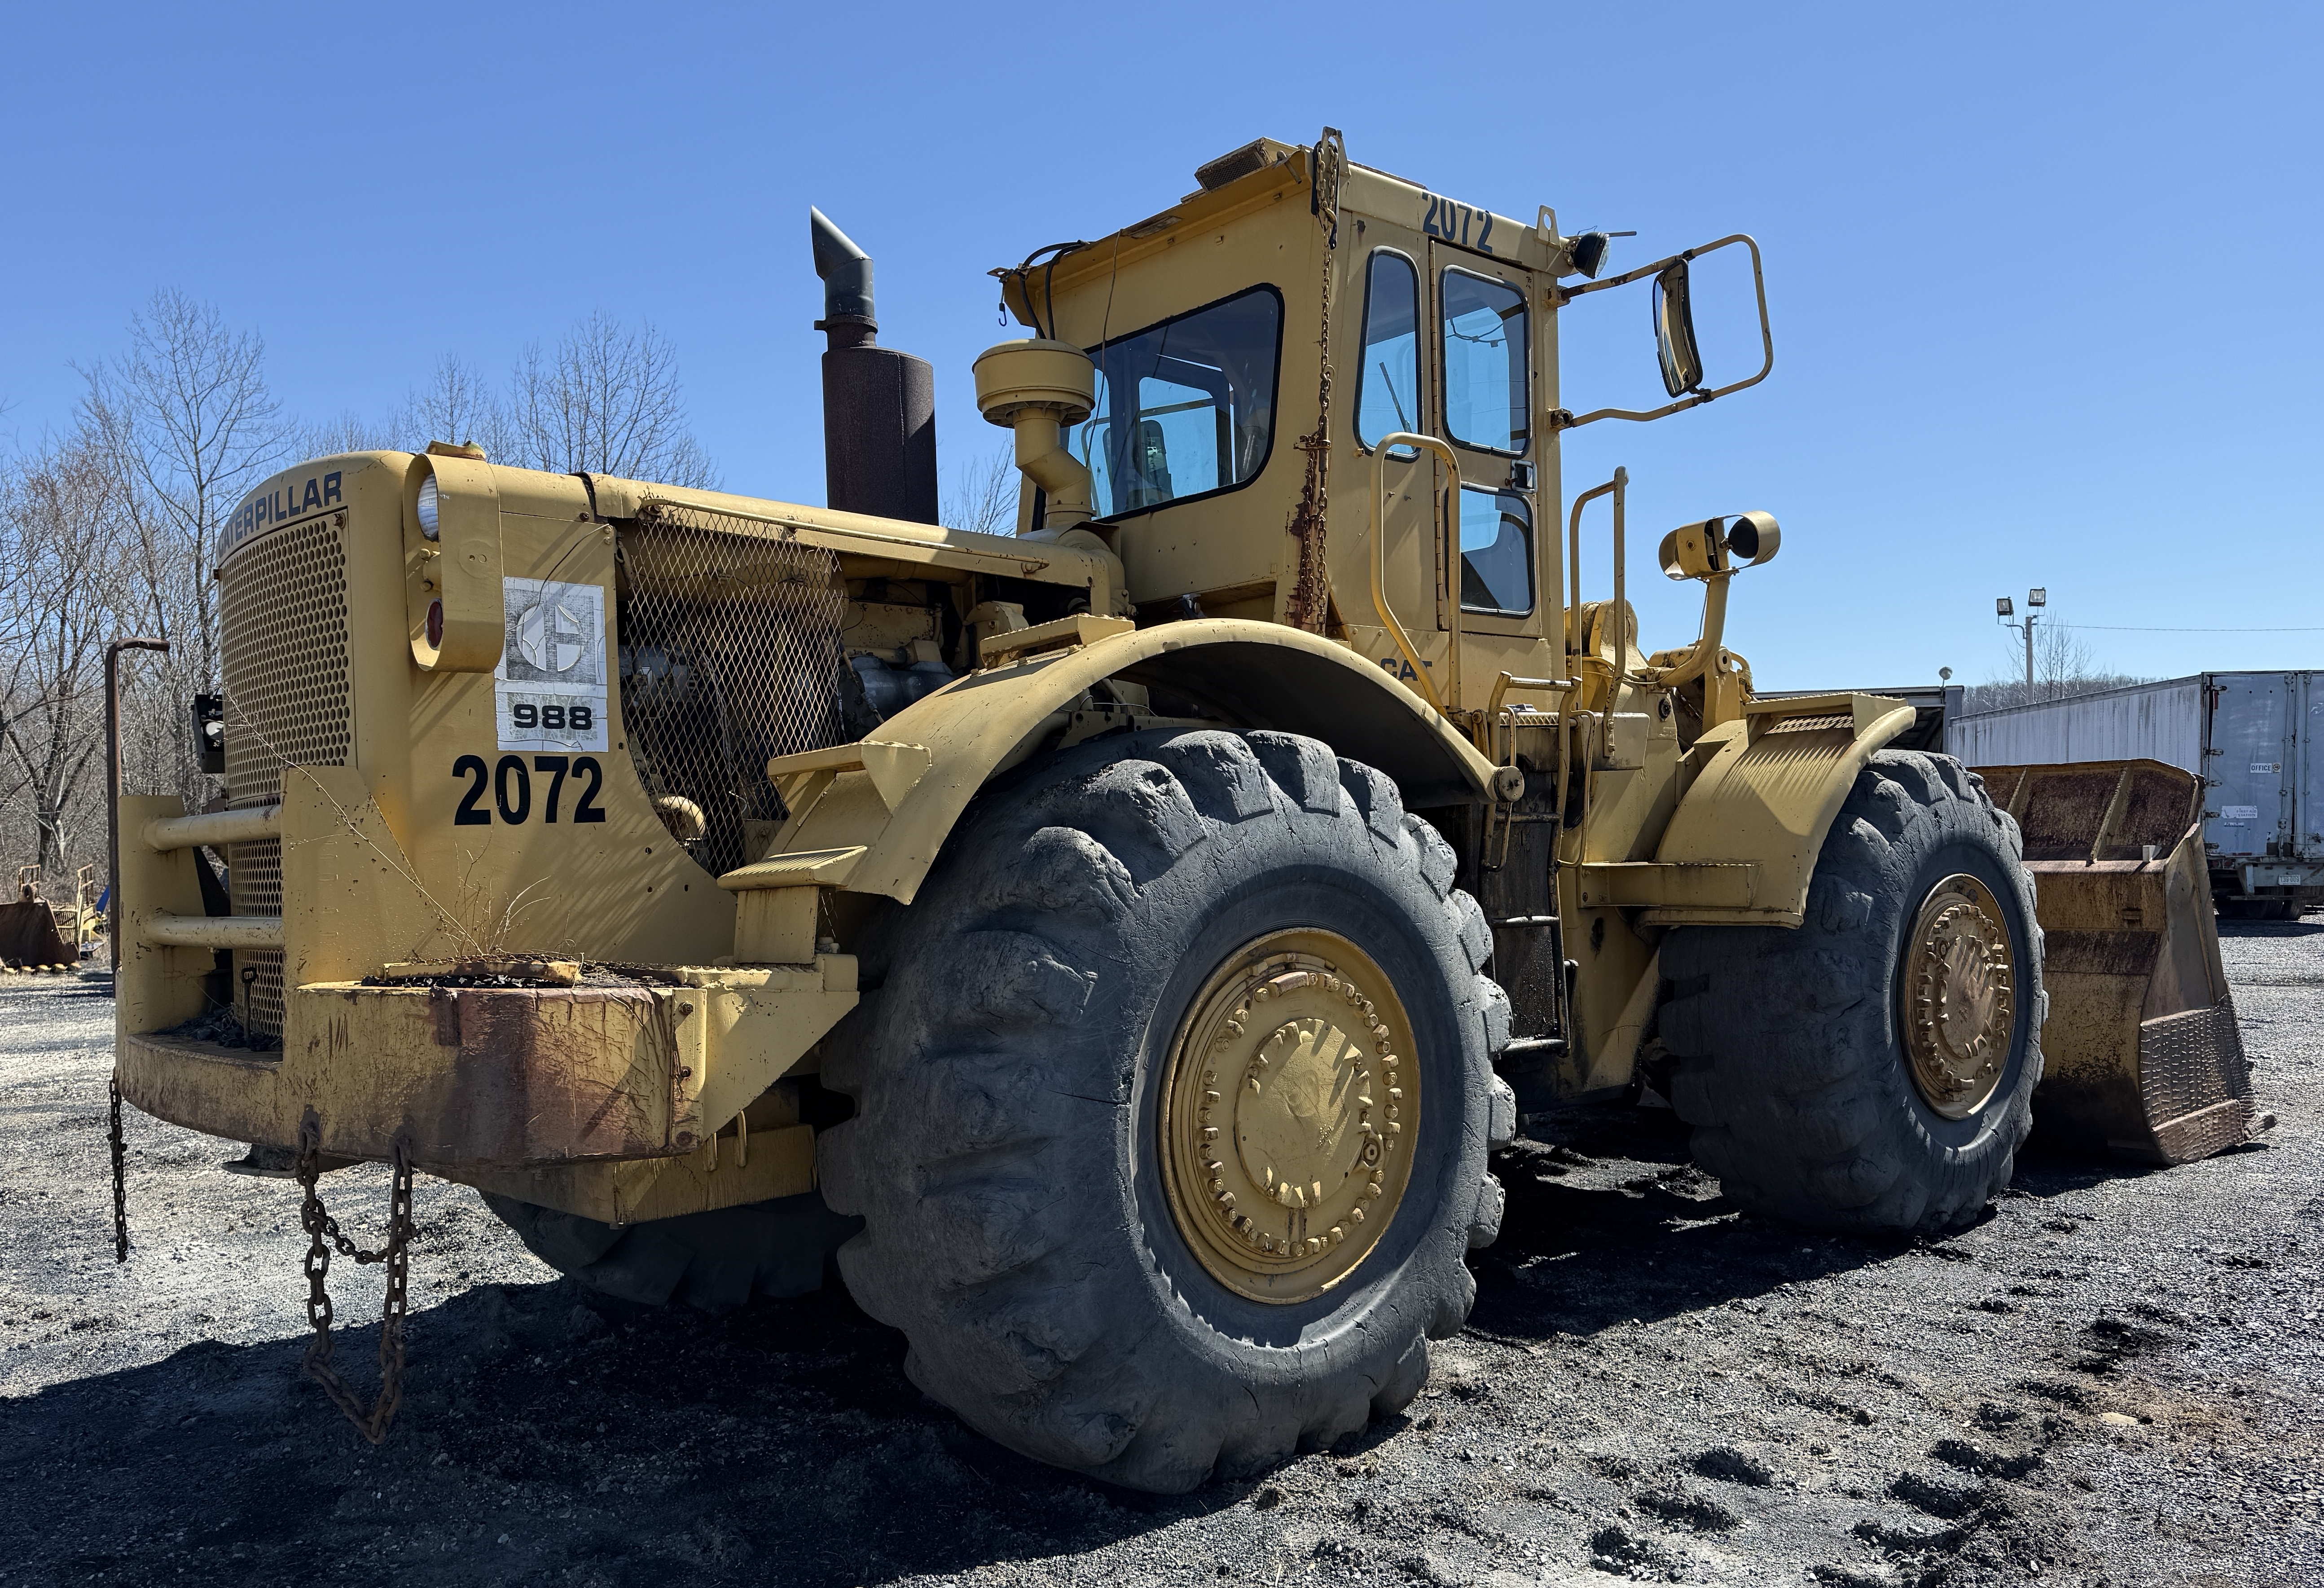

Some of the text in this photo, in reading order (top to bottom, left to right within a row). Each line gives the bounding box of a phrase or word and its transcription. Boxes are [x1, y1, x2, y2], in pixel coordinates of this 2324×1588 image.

[1421, 191, 1493, 253] 2072
[218, 471, 342, 558] CATERPILLAR
[513, 704, 592, 730] 988
[452, 755, 606, 825] 2072
